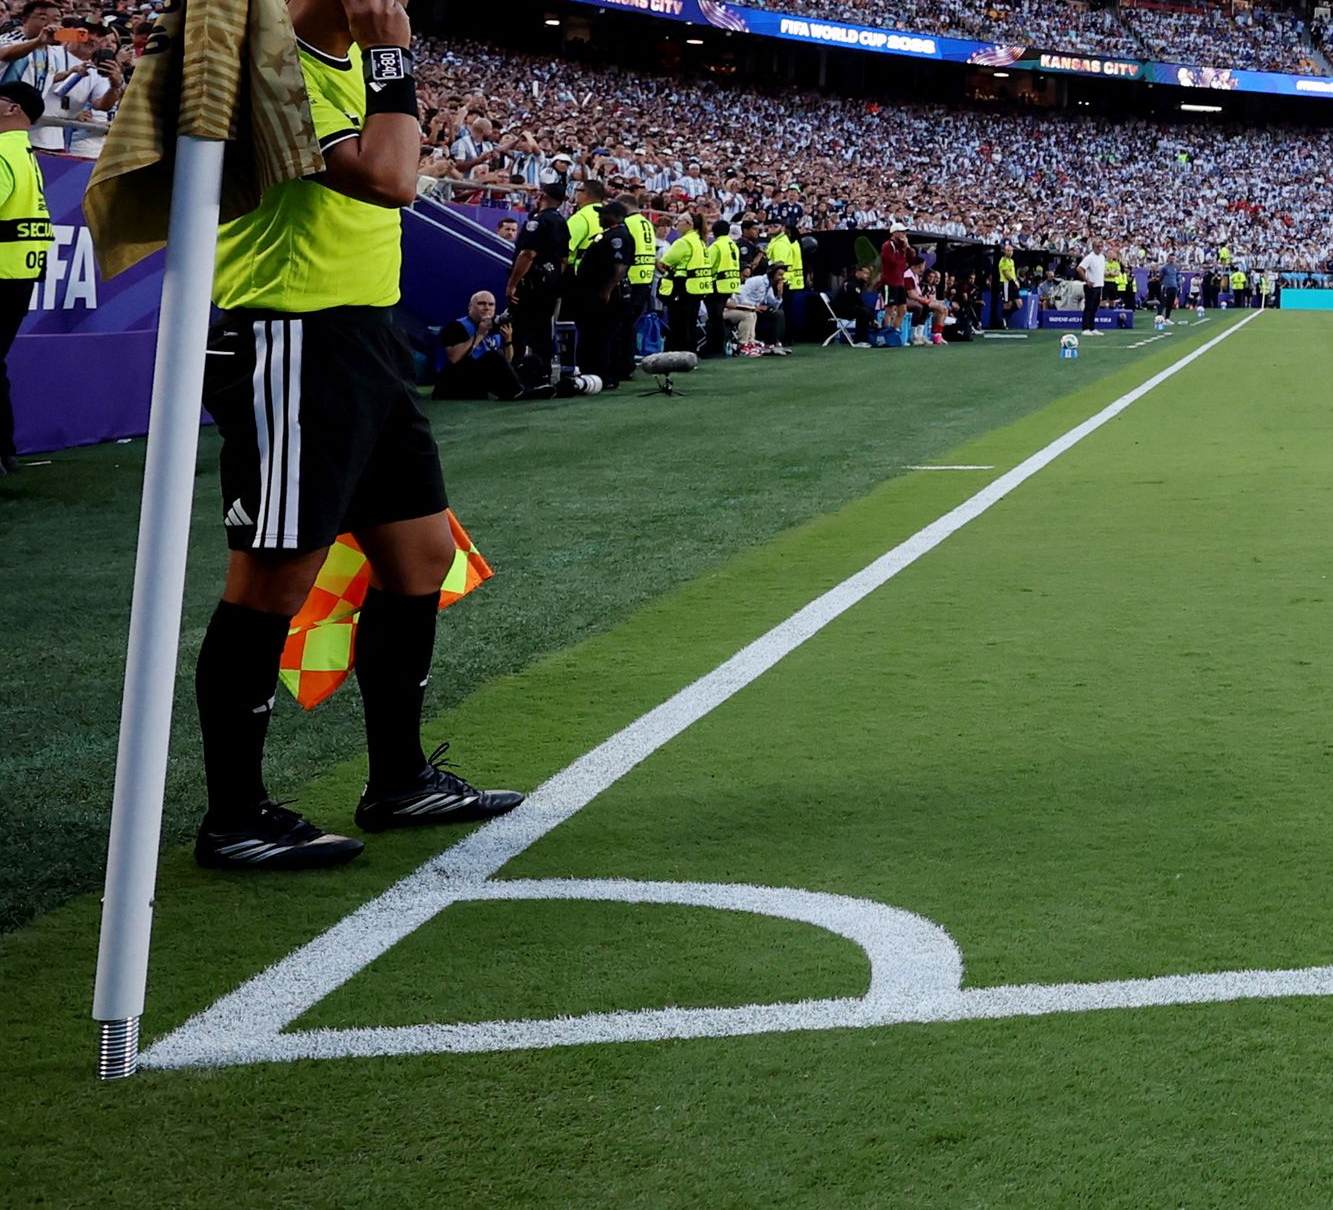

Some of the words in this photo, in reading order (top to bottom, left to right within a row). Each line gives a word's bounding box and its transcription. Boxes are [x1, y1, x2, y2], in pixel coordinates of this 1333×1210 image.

[780, 19, 810, 37] FIFA
[810, 24, 859, 43] WORLD
[859, 31, 887, 47] CUP
[1040, 54, 1100, 73] KANSAS
[1103, 61, 1138, 76] CITY
